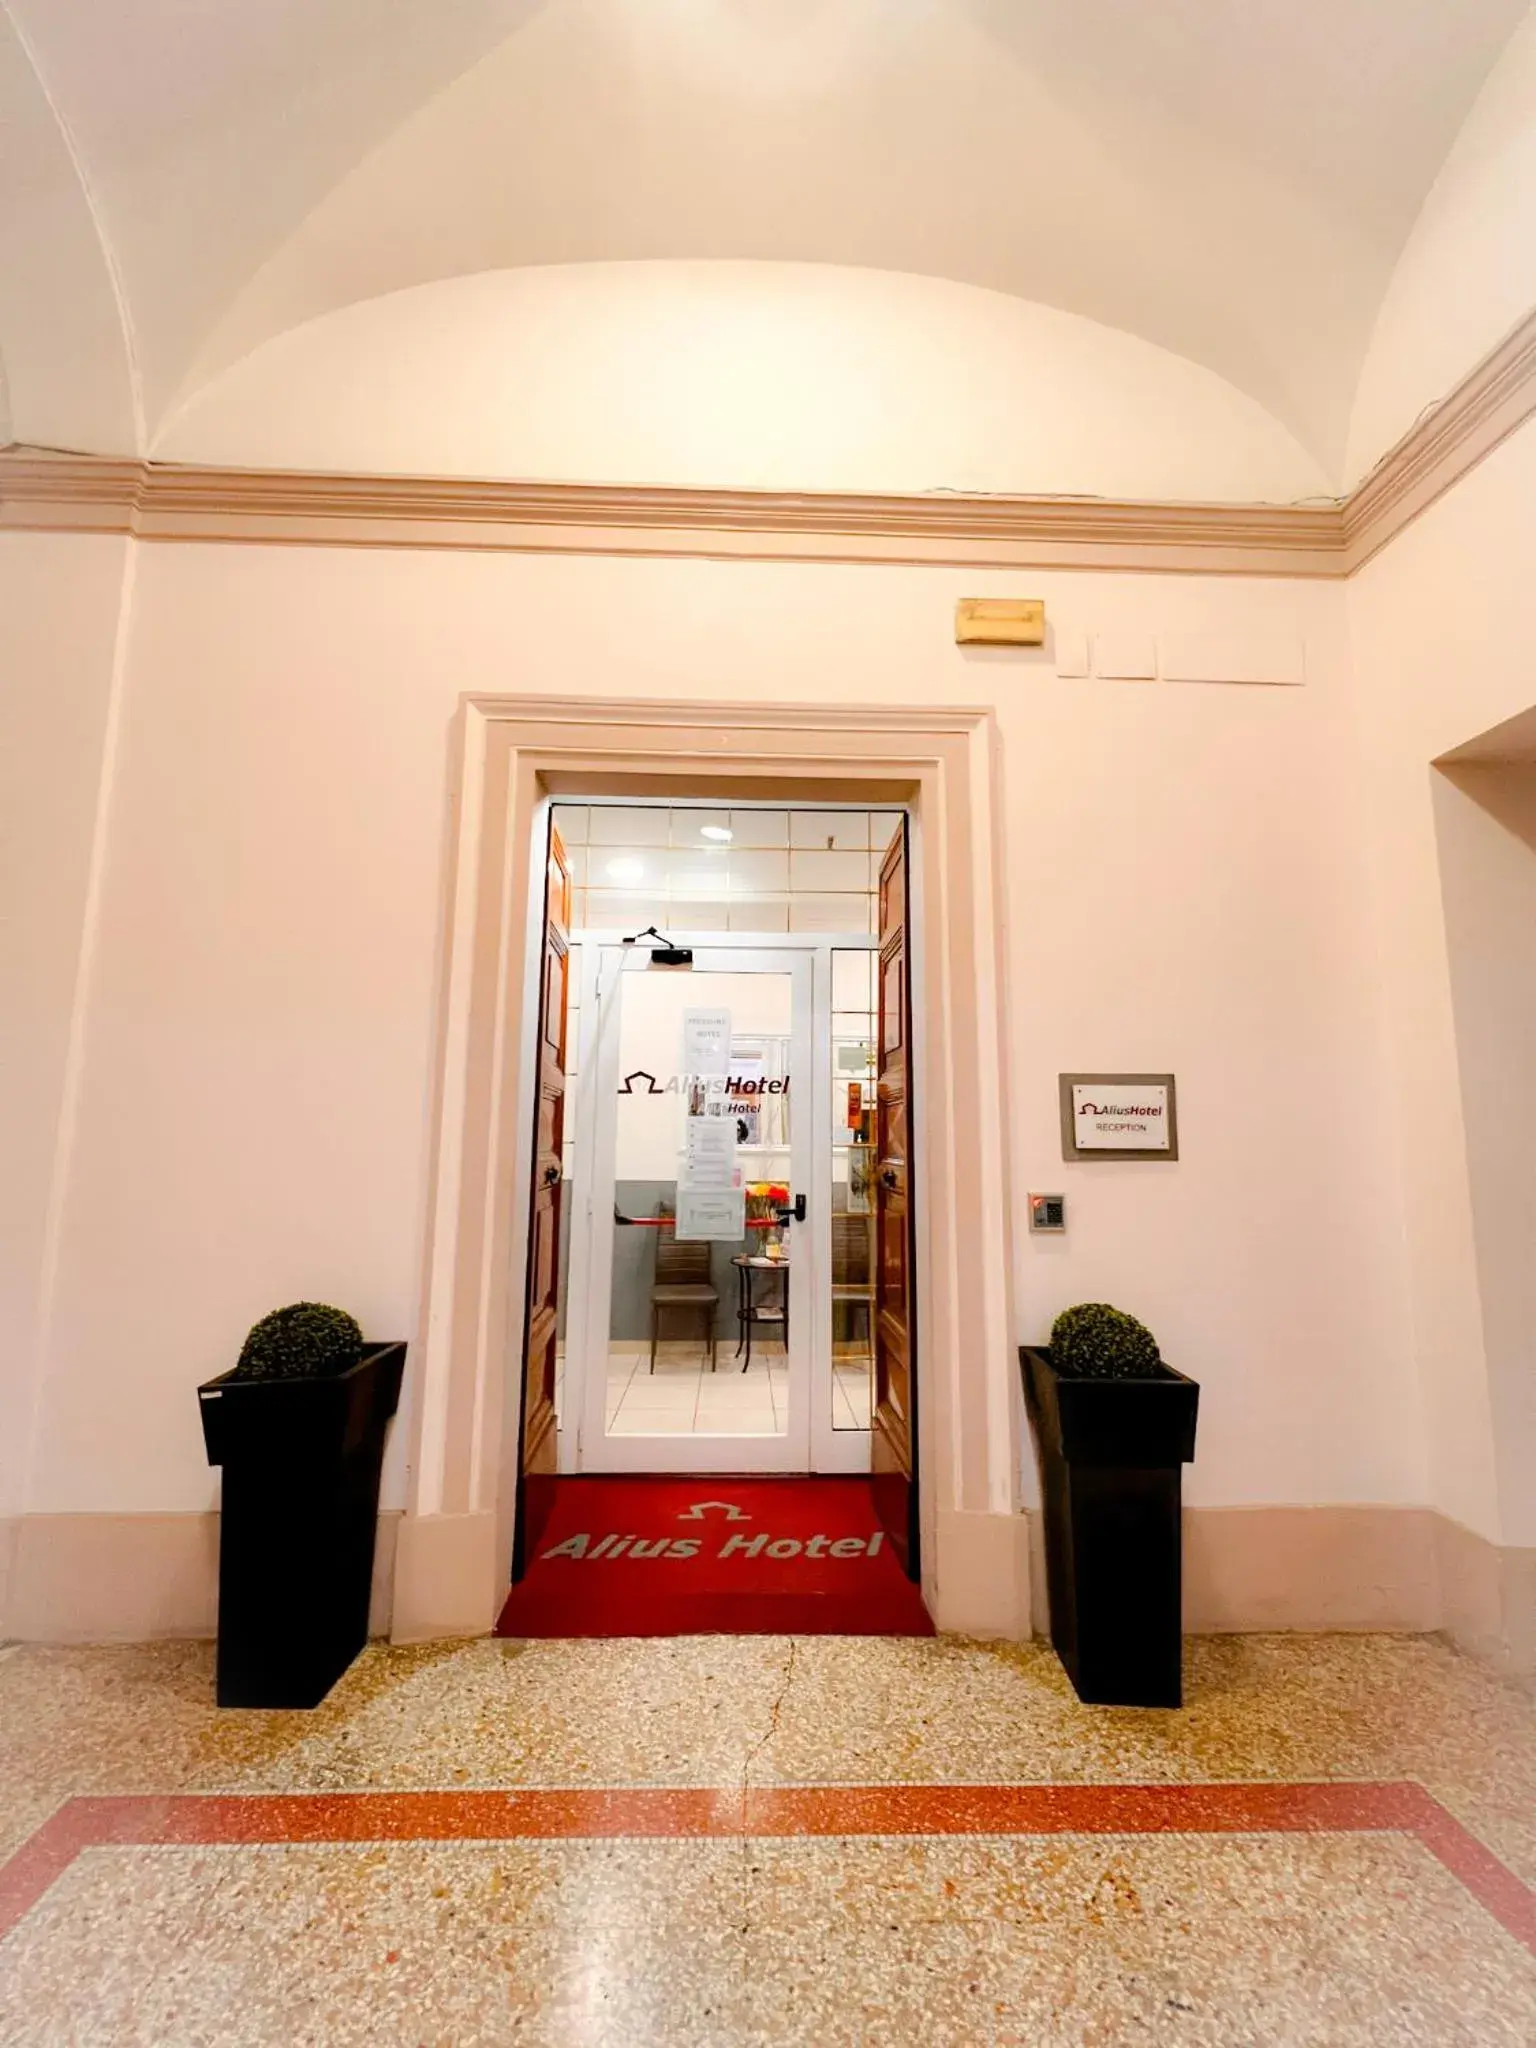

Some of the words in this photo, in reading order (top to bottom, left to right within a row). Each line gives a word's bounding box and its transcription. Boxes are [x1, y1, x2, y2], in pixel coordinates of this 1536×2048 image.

[1101, 1105, 1162, 1116] AliusHotel
[1095, 1123, 1147, 1132] RECEPTION
[541, 1533, 703, 1559] Alius
[717, 1532, 884, 1559] Hotel
